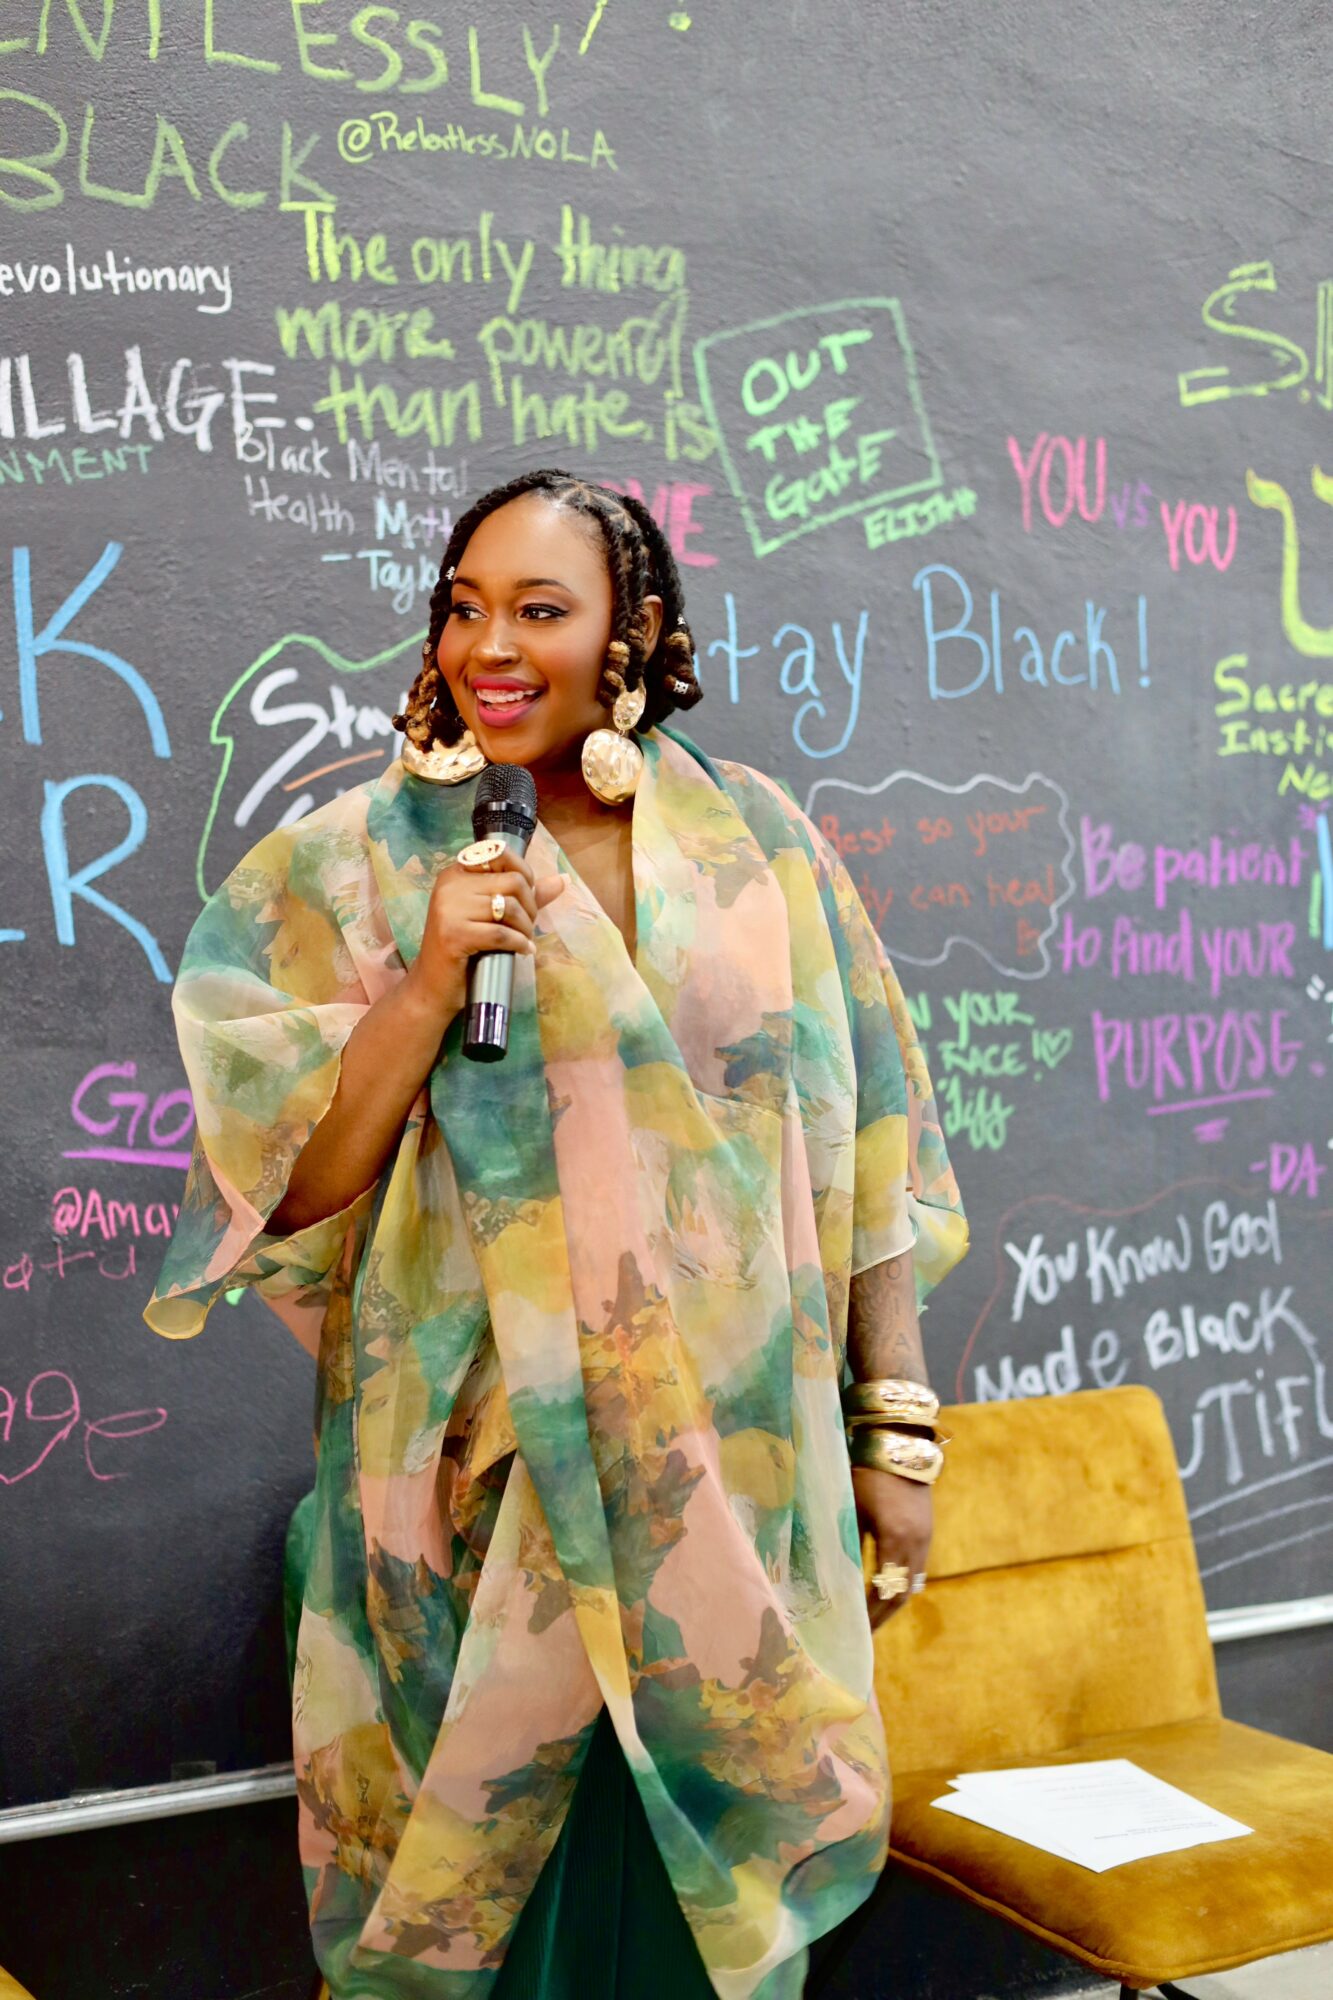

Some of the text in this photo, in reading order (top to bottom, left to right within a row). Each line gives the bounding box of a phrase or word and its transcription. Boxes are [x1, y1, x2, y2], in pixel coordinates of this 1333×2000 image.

[411, 211, 535, 315] only
[313, 364, 483, 448] than
[663, 389, 727, 461] is
[741, 329, 874, 416] OUT
[235, 421, 332, 480] Black
[1006, 430, 1107, 533] YOU
[1160, 498, 1239, 572] YOU
[693, 592, 870, 760] tay
[917, 815, 955, 846] so
[1079, 814, 1147, 899] Be
[909, 882, 973, 912] can
[1056, 911, 1102, 975] to
